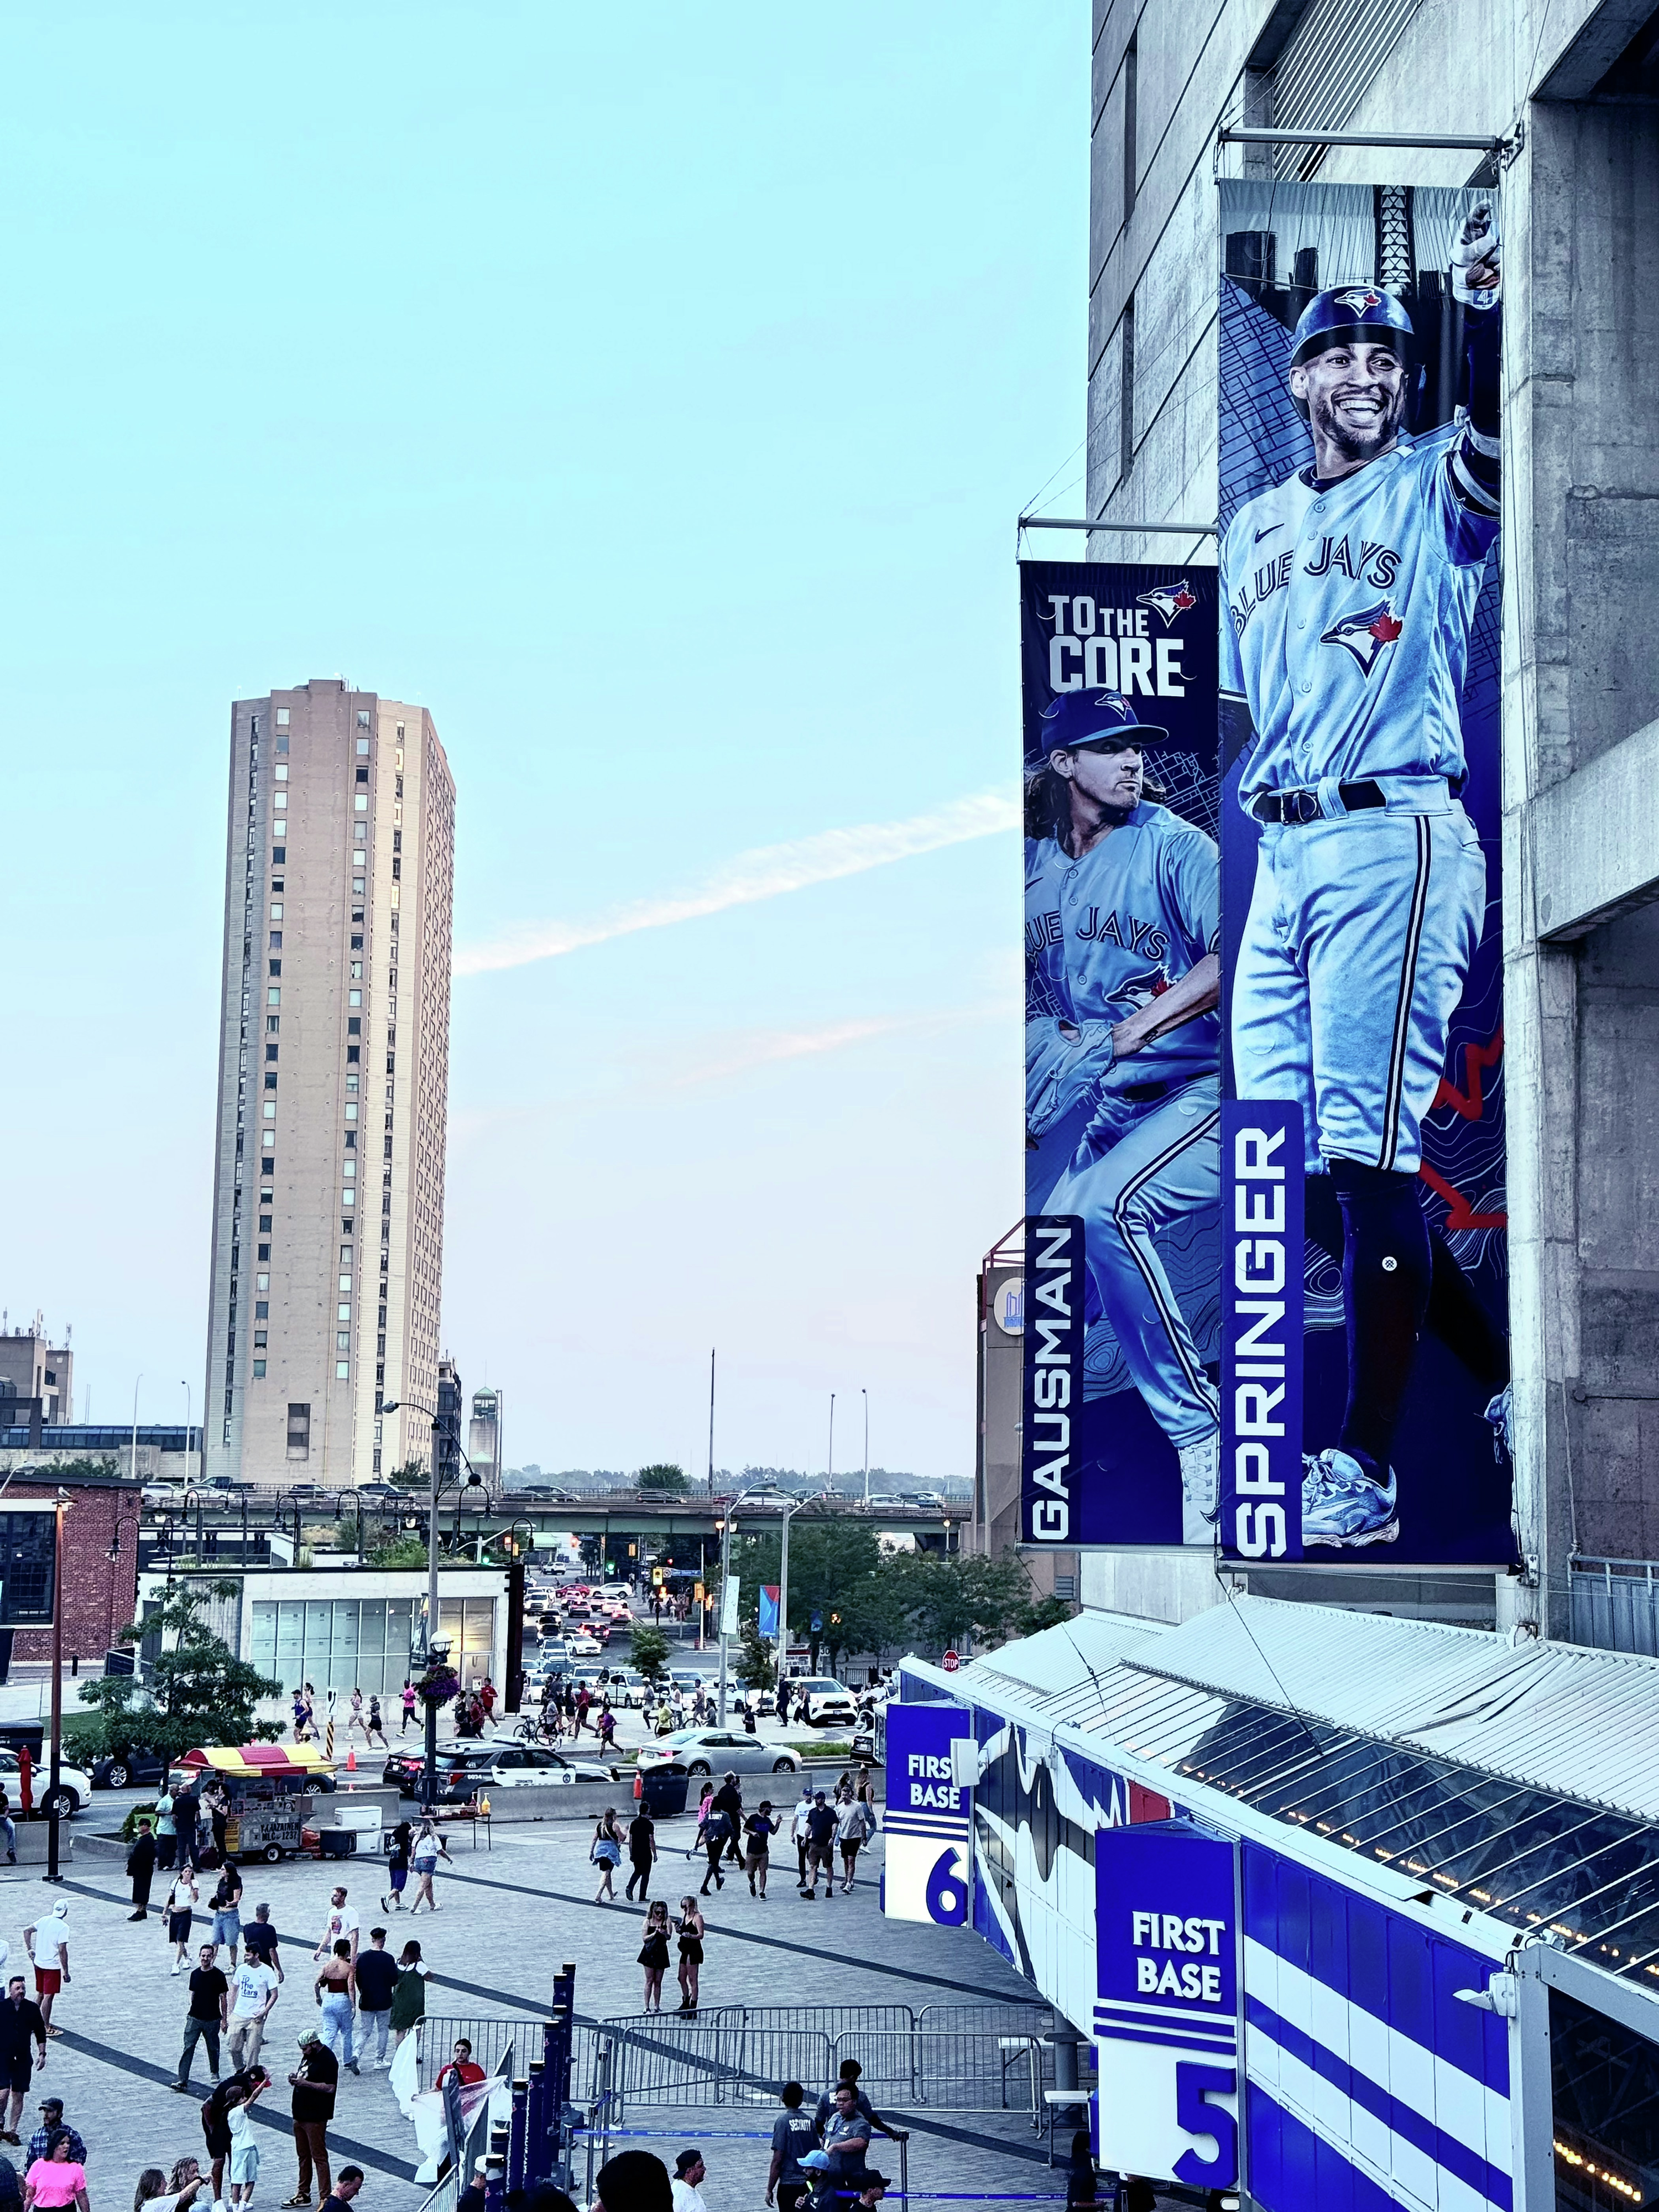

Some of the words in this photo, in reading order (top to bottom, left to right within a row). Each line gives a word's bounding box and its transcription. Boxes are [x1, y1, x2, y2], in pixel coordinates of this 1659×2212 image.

[1230, 549, 1294, 638] BLUE
[1303, 533, 1402, 589] JAYS
[1048, 595, 1095, 635] TO
[1099, 608, 1149, 637] THE
[1050, 635, 1185, 697] CORE
[1076, 906, 1170, 961] JAYS
[1235, 1126, 1287, 1558] SPRINGER
[1034, 1228, 1072, 1541] GAUSMAN
[944, 1658, 958, 1669] STOP
[908, 1754, 952, 1780] FIRS
[910, 1783, 961, 1810] BASE
[926, 1847, 968, 1927] 6
[1132, 1911, 1226, 1955] FIRST
[1137, 1957, 1222, 2002] BASE
[1172, 2059, 1239, 2190] 5
